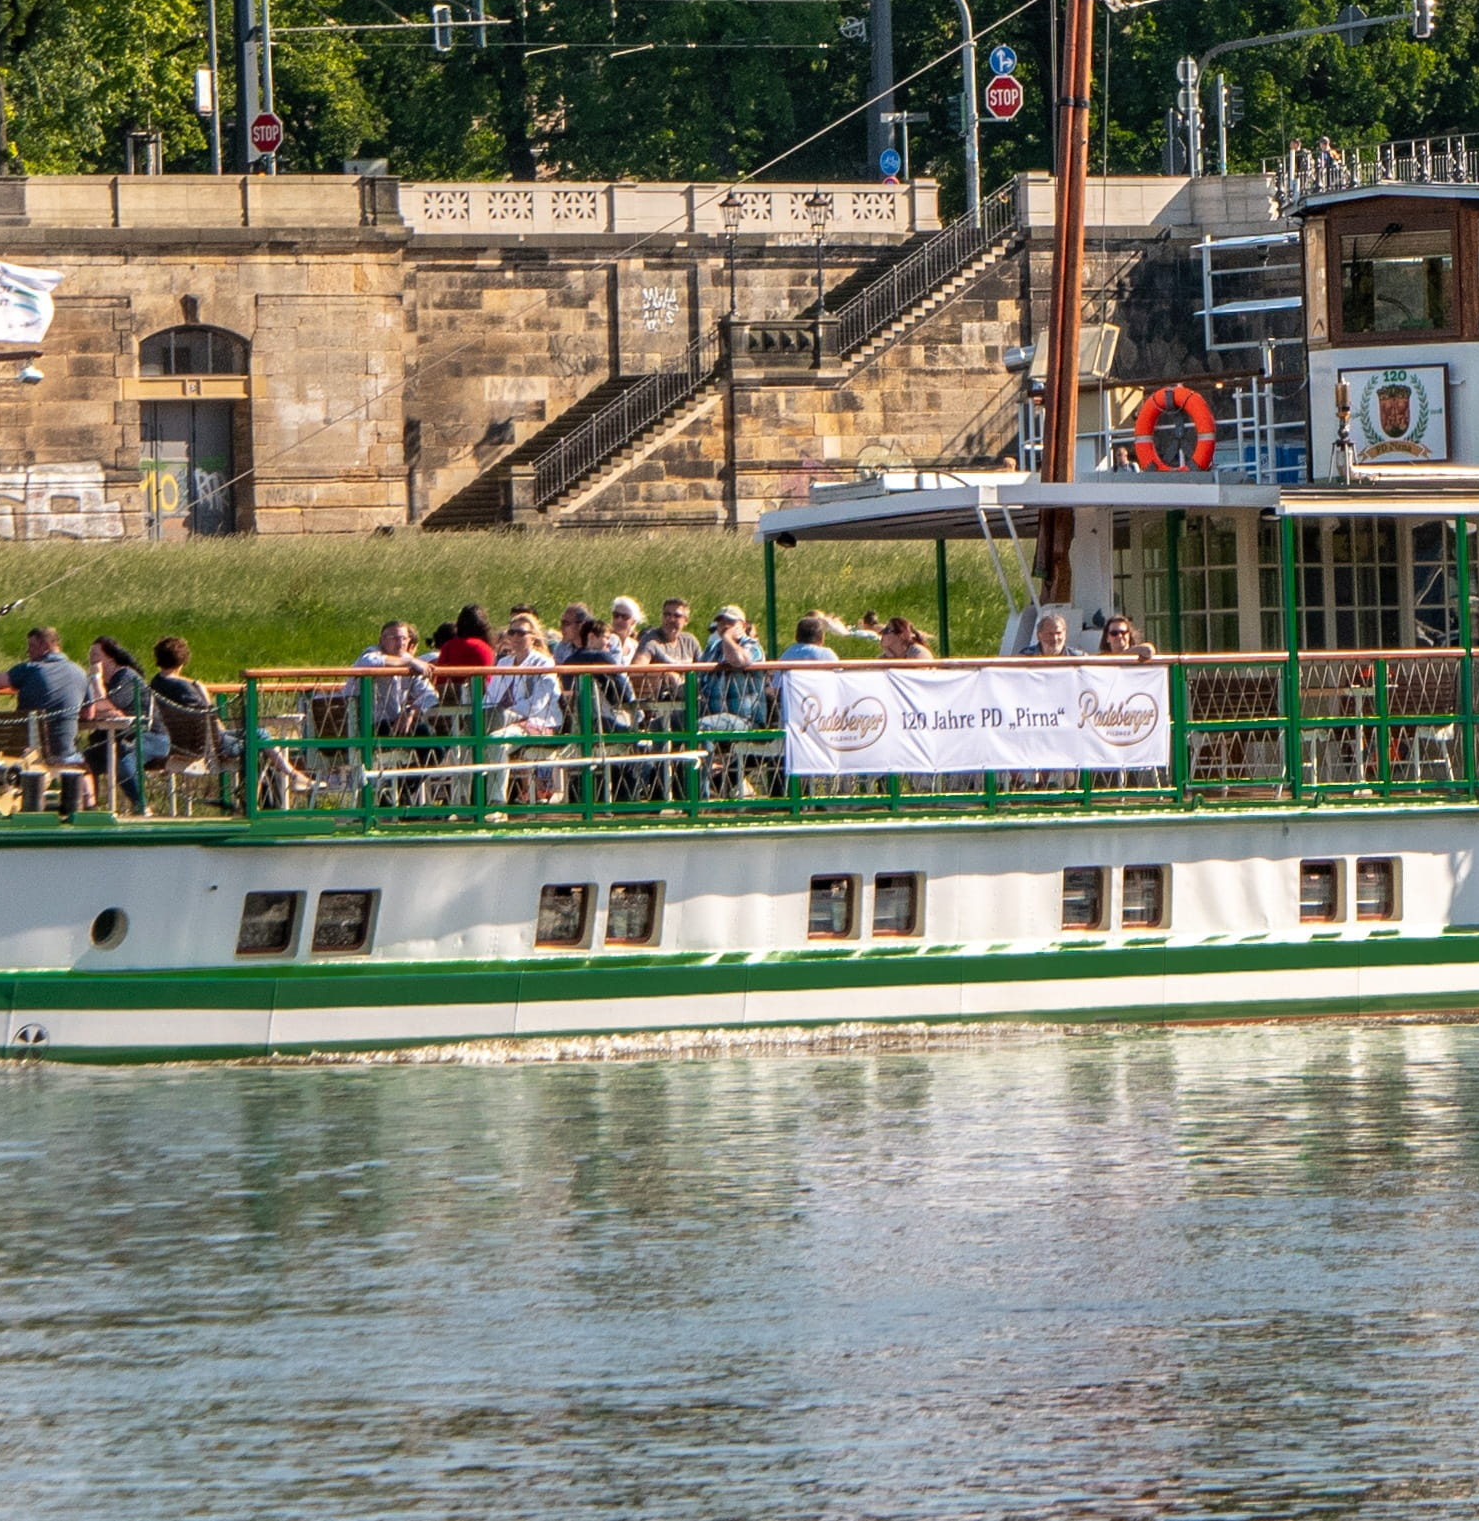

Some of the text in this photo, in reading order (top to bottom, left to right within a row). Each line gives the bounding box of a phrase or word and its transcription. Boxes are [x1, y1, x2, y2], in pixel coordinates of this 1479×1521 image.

[989, 88, 1019, 106] STOP
[253, 125, 279, 142] STOP
[1383, 370, 1407, 382] 120
[800, 692, 885, 742] Radeberger
[902, 707, 1065, 731] 120 Jahre PD „Pirna“
[1078, 688, 1156, 738] Radeberger
